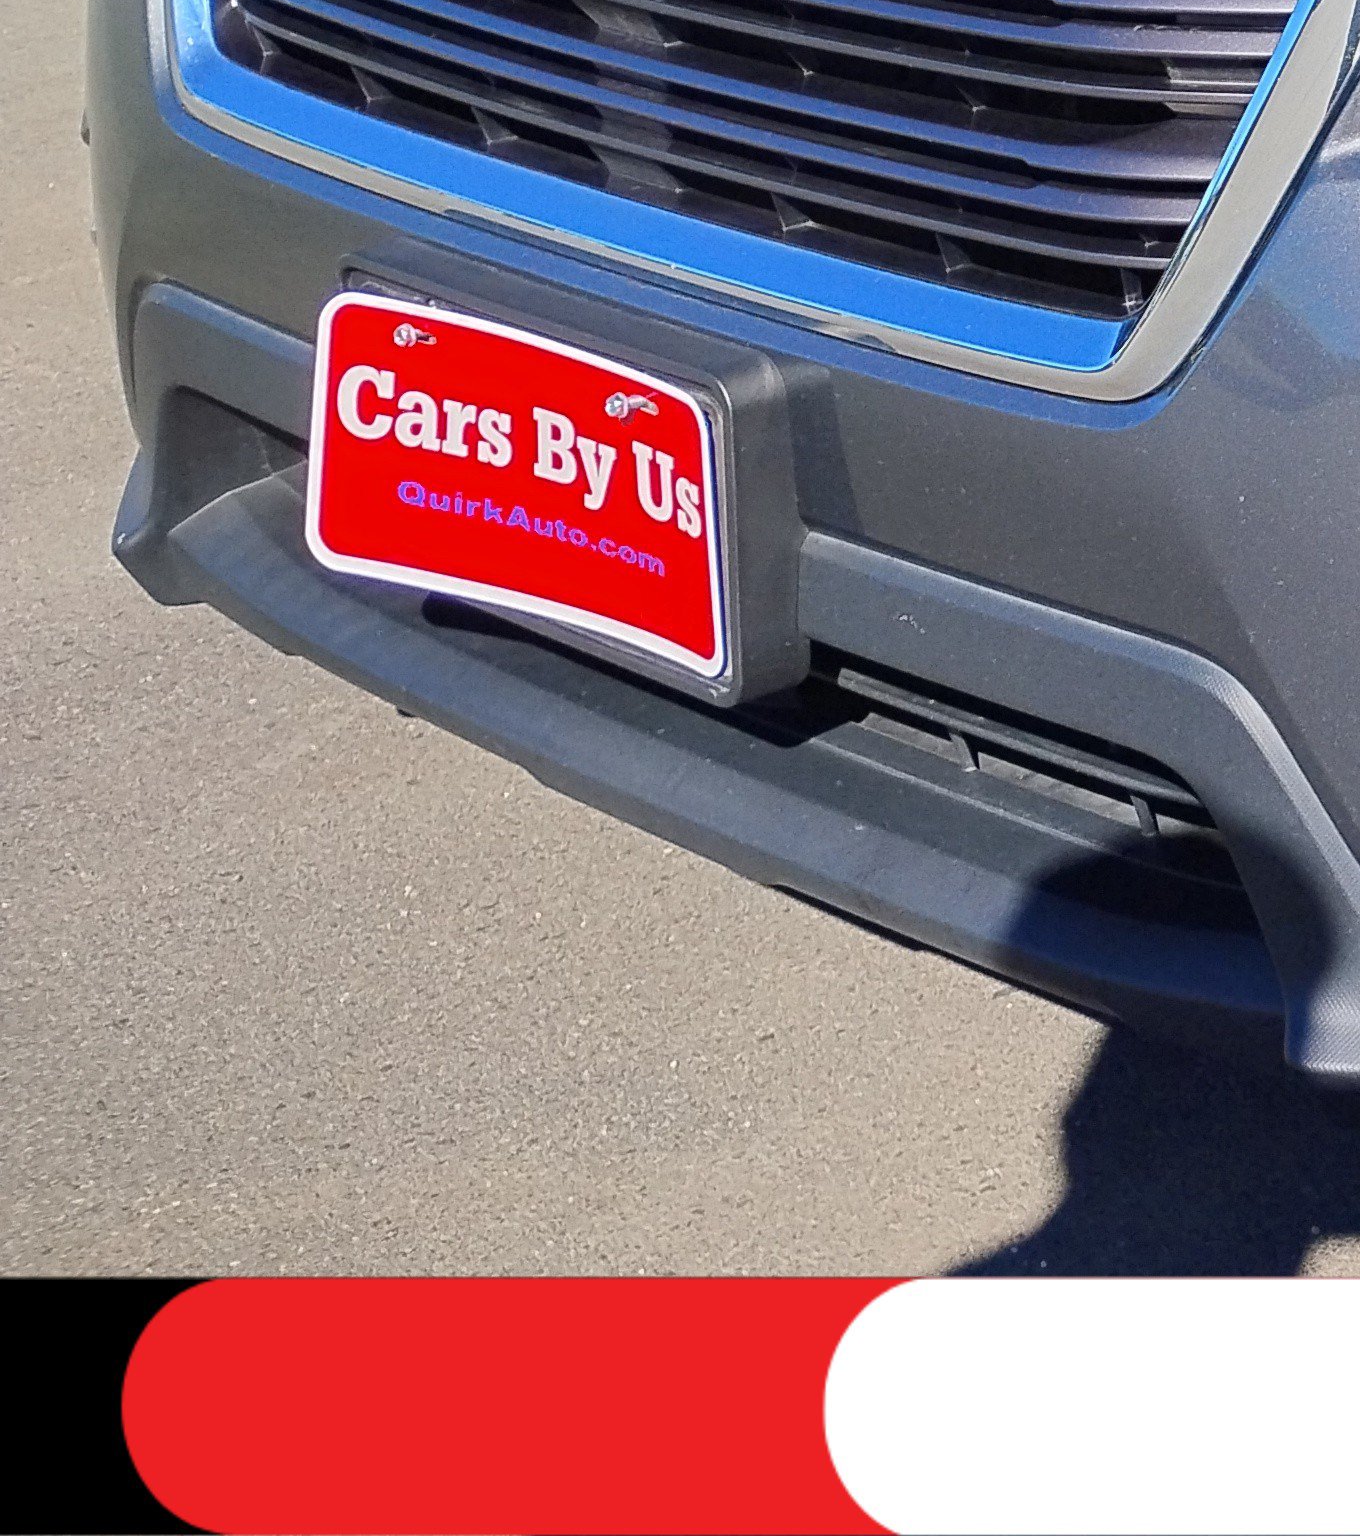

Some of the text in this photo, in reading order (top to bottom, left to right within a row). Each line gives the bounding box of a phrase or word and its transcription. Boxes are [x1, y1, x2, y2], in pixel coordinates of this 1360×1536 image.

[337, 364, 703, 539] Cars By Us
[396, 479, 667, 577] QuirkAuto.com
